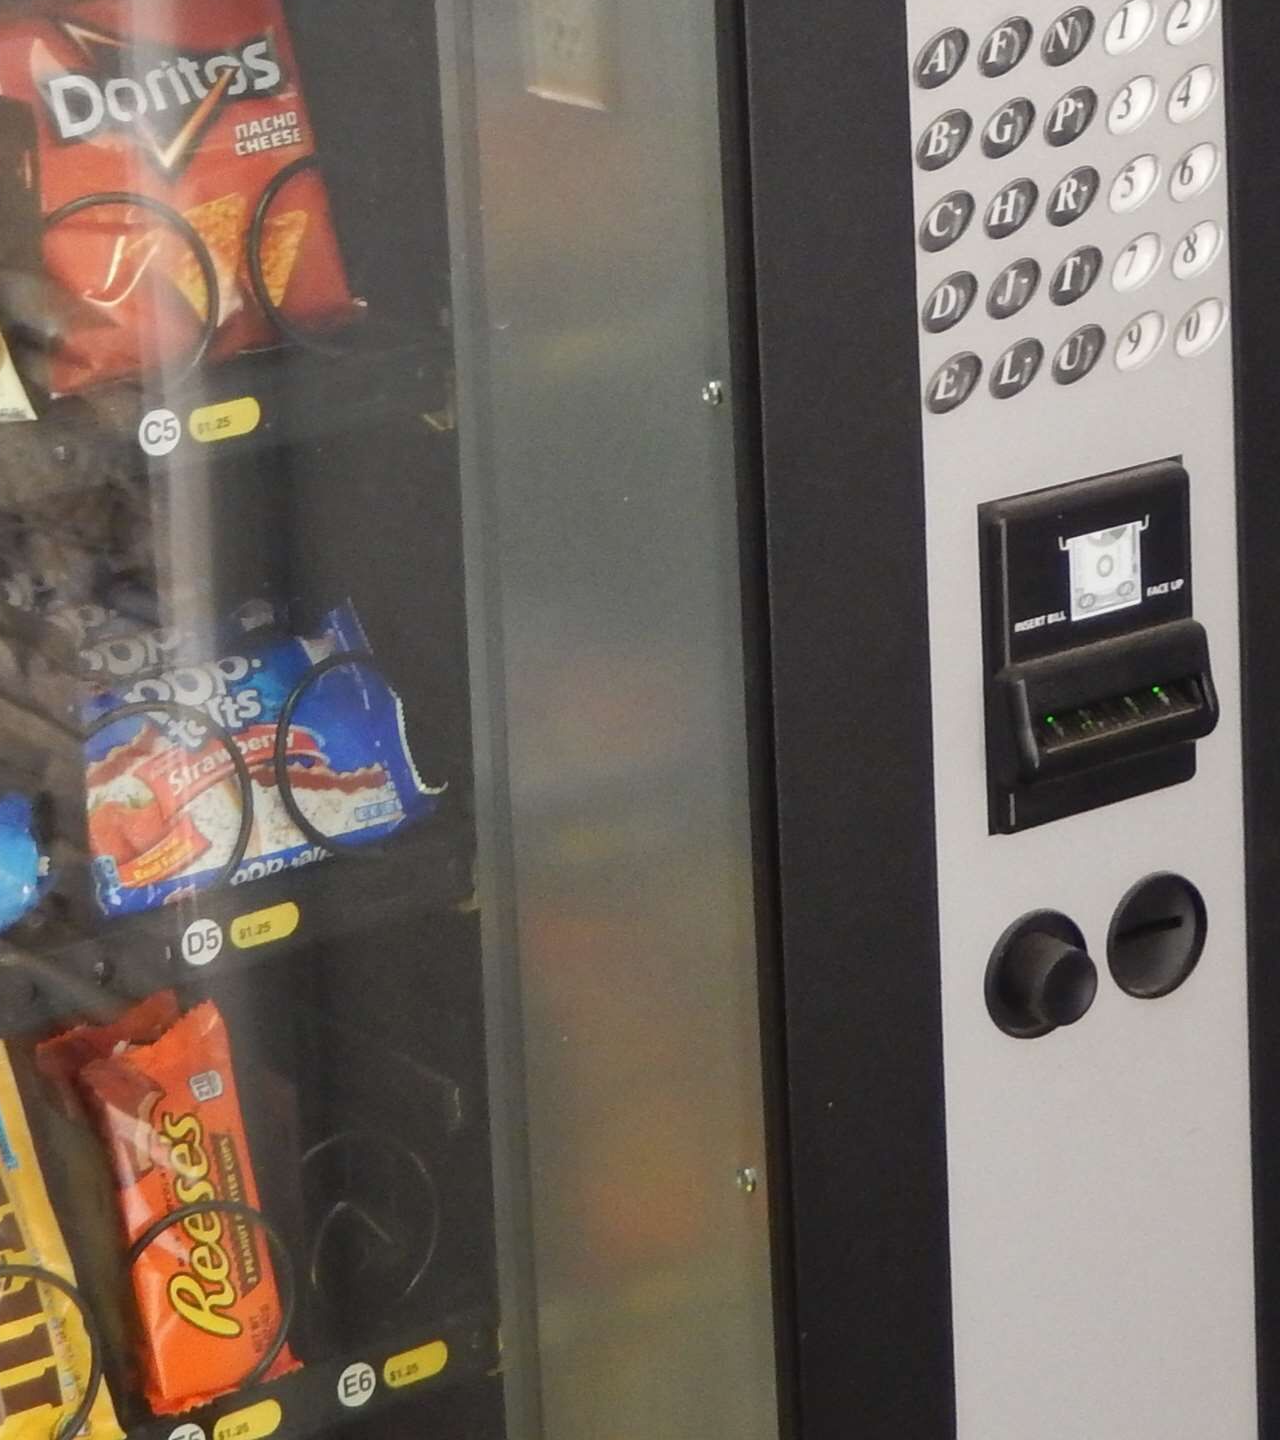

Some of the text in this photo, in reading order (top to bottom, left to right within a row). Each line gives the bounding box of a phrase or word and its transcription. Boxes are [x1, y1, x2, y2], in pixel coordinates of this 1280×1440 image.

[922, 37, 947, 75] A
[986, 26, 1013, 64] F
[1047, 16, 1075, 53] N
[1118, 7, 1129, 40] 1
[49, 38, 281, 140] Doritos
[234, 110, 299, 140] NACHO
[926, 75, 1193, 158] B G P 3 4
[234, 126, 304, 158] CHEESE
[928, 154, 1194, 237] C H R 5 6
[931, 232, 1198, 320] D J T 7 8
[934, 309, 1201, 400] E L U 9 0
[144, 418, 179, 445] C5
[1147, 578, 1185, 597] FACE UP
[1014, 611, 1067, 633] INSERT BILL
[186, 926, 220, 956] D5
[162, 1110, 243, 1338] Reese's
[342, 1368, 372, 1398] E6
